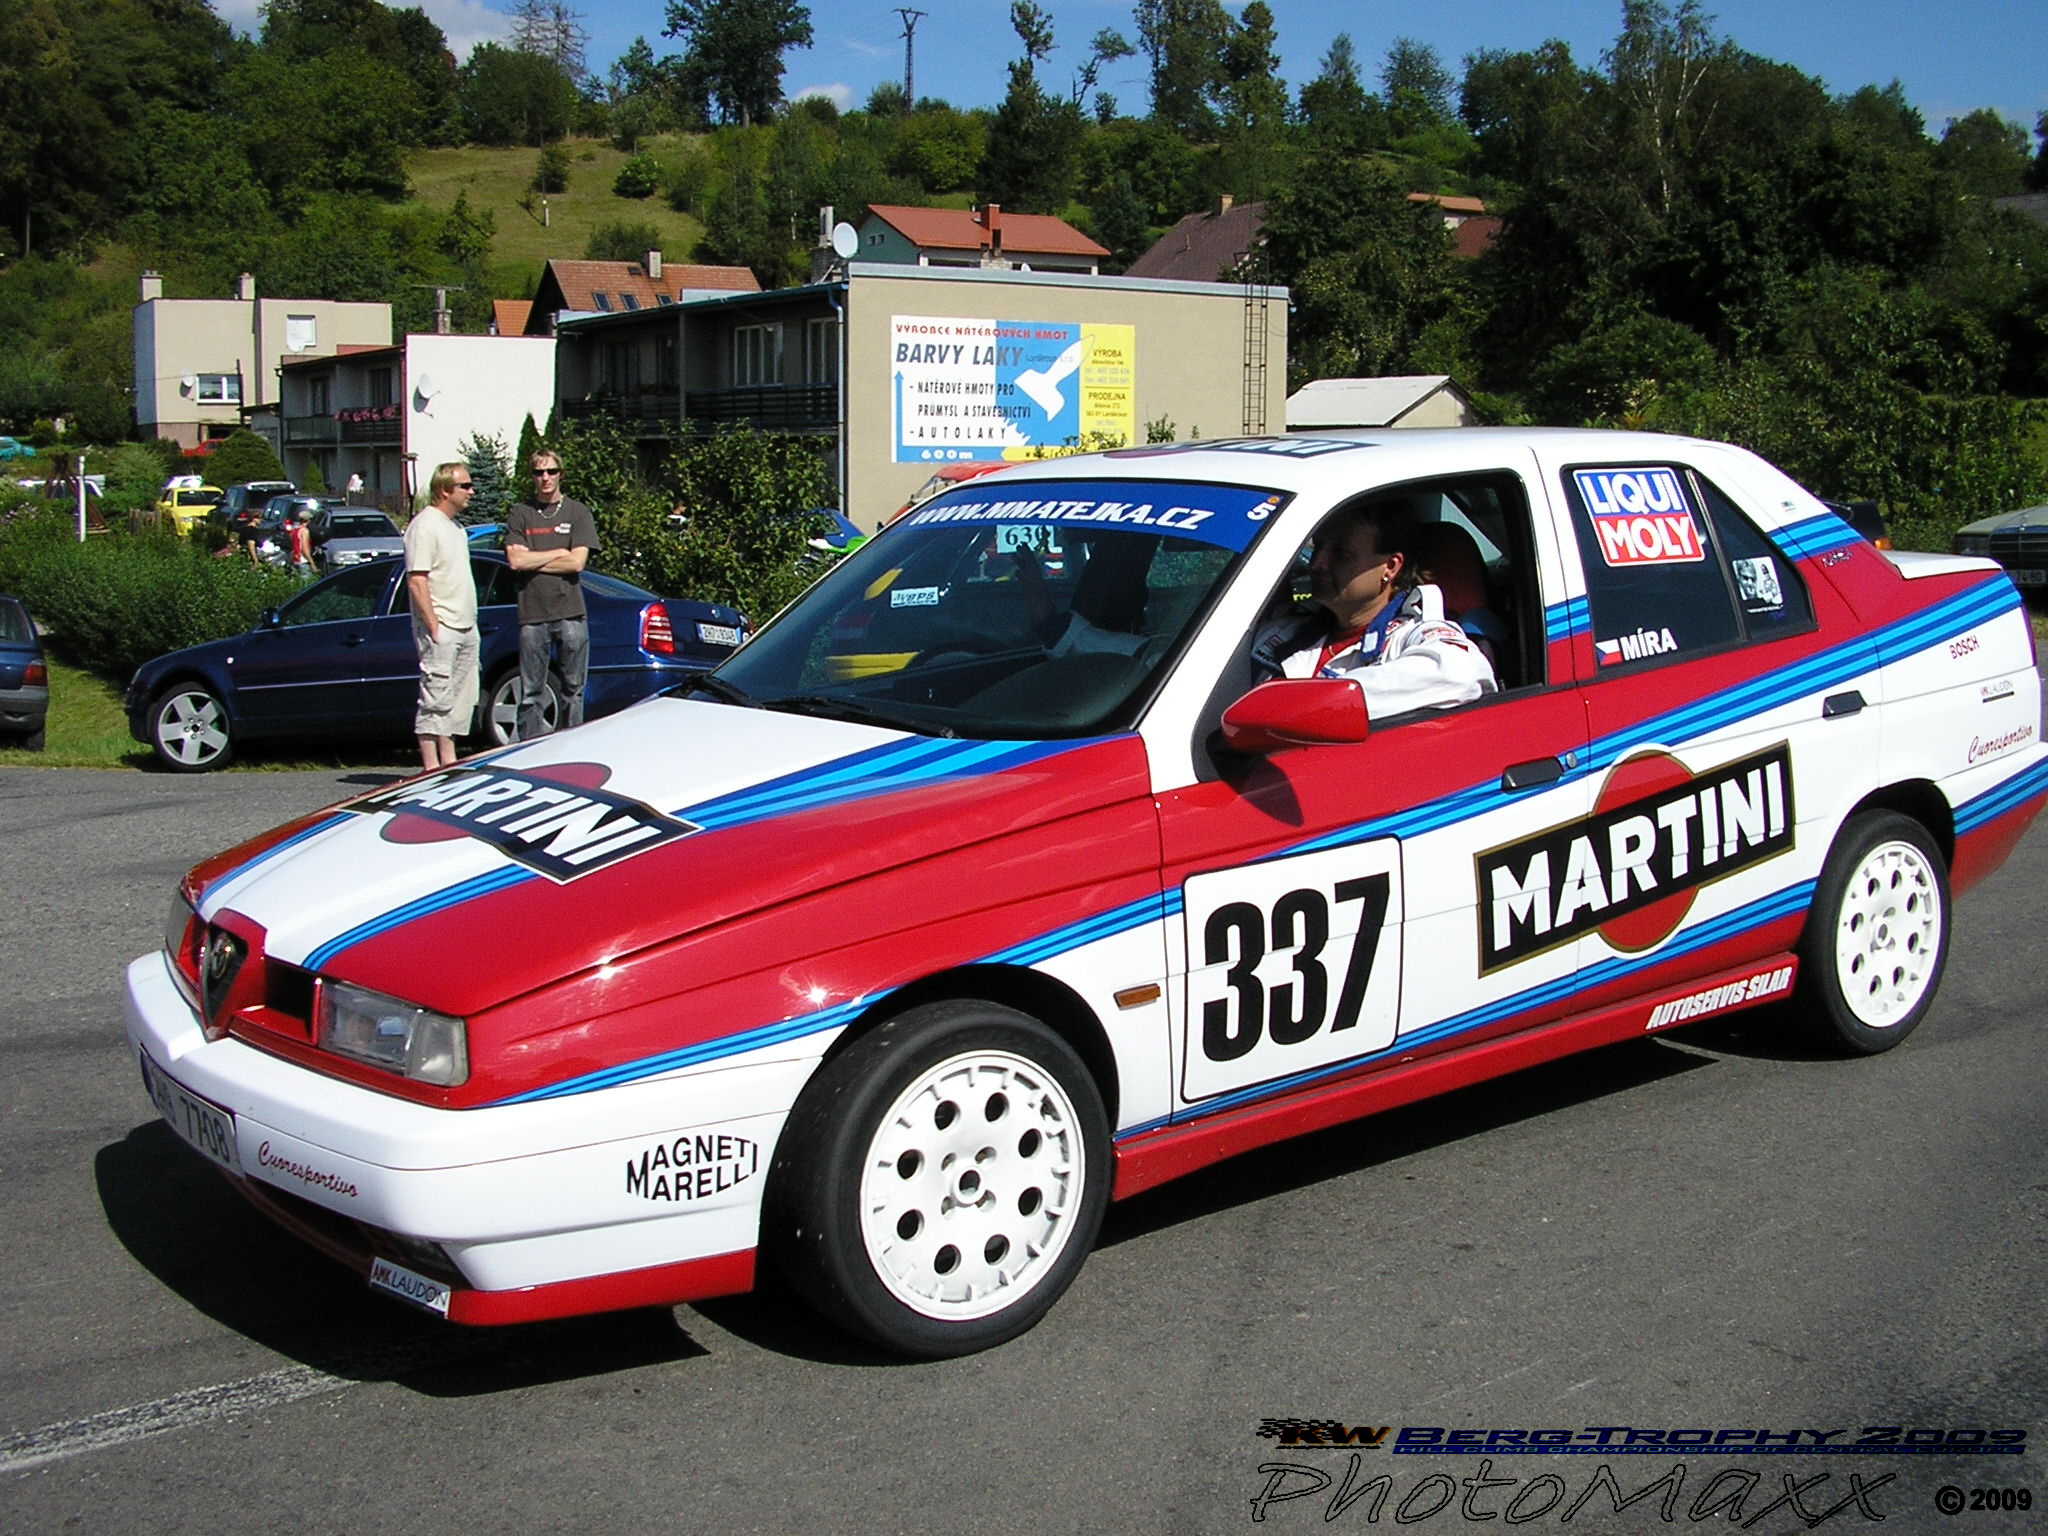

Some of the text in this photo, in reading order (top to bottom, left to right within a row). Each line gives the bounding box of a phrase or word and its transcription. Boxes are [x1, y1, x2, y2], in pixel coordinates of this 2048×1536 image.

[896, 322, 950, 335] VÝROBCE
[1035, 328, 1069, 340] HMOT
[896, 342, 965, 364] BARVY
[972, 345, 1024, 367] LAKY
[917, 379, 1015, 396] NÁTĚROVÉ HMOTY PRO
[1088, 391, 1126, 402] PRODEJNA
[964, 405, 970, 417] A
[1581, 473, 1683, 515] LIQUI
[1598, 517, 1694, 560] MOLY
[1950, 635, 1979, 659] BOSCH
[368, 774, 662, 866] MARTINI
[1491, 760, 1785, 952] MARTINI
[1202, 871, 1390, 1062] 337
[1645, 979, 1749, 1030] AUTOSERVIS
[626, 1135, 758, 1188] MAGNETI
[626, 1148, 758, 1201] MARELLI
